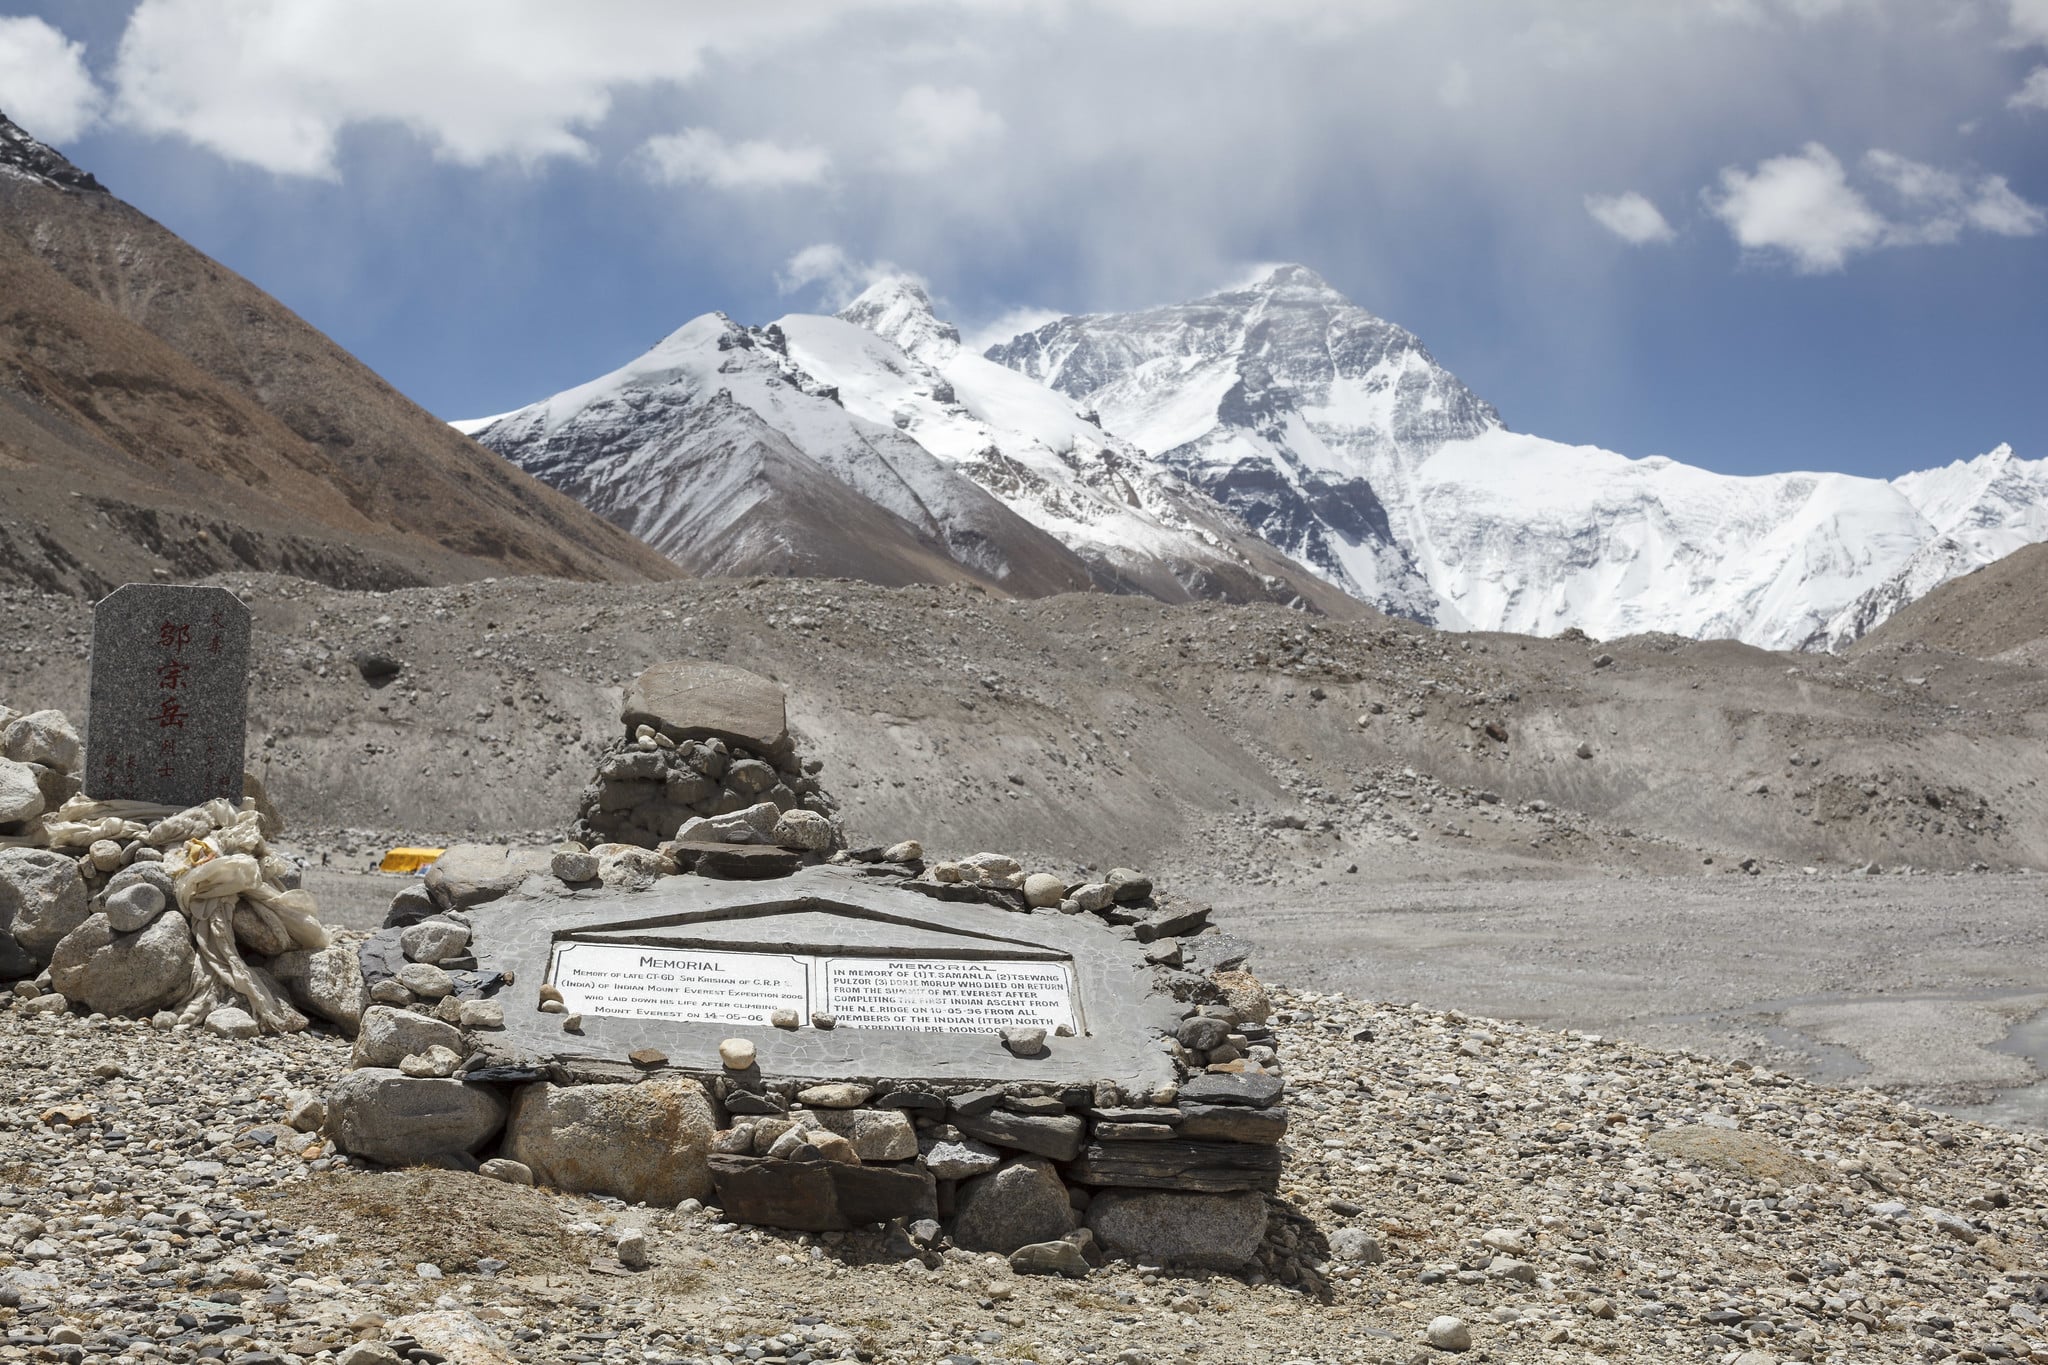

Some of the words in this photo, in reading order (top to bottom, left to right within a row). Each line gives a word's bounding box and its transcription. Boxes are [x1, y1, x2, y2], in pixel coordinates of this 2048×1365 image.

[640, 956, 726, 972] MEMORIAL
[888, 963, 997, 972] MEMORIAL
[573, 969, 608, 977] MEMORY
[698, 976, 736, 984] KRISHAN
[561, 980, 596, 989] (INDIA)
[684, 987, 726, 996] EVEREST
[728, 990, 778, 998] EXPEDITION
[595, 1006, 632, 1014] MOUNT
[636, 1008, 684, 1017] EVEREST
[704, 1012, 764, 1022] 14-05-06
[978, 1017, 1012, 1025] (ITBP)
